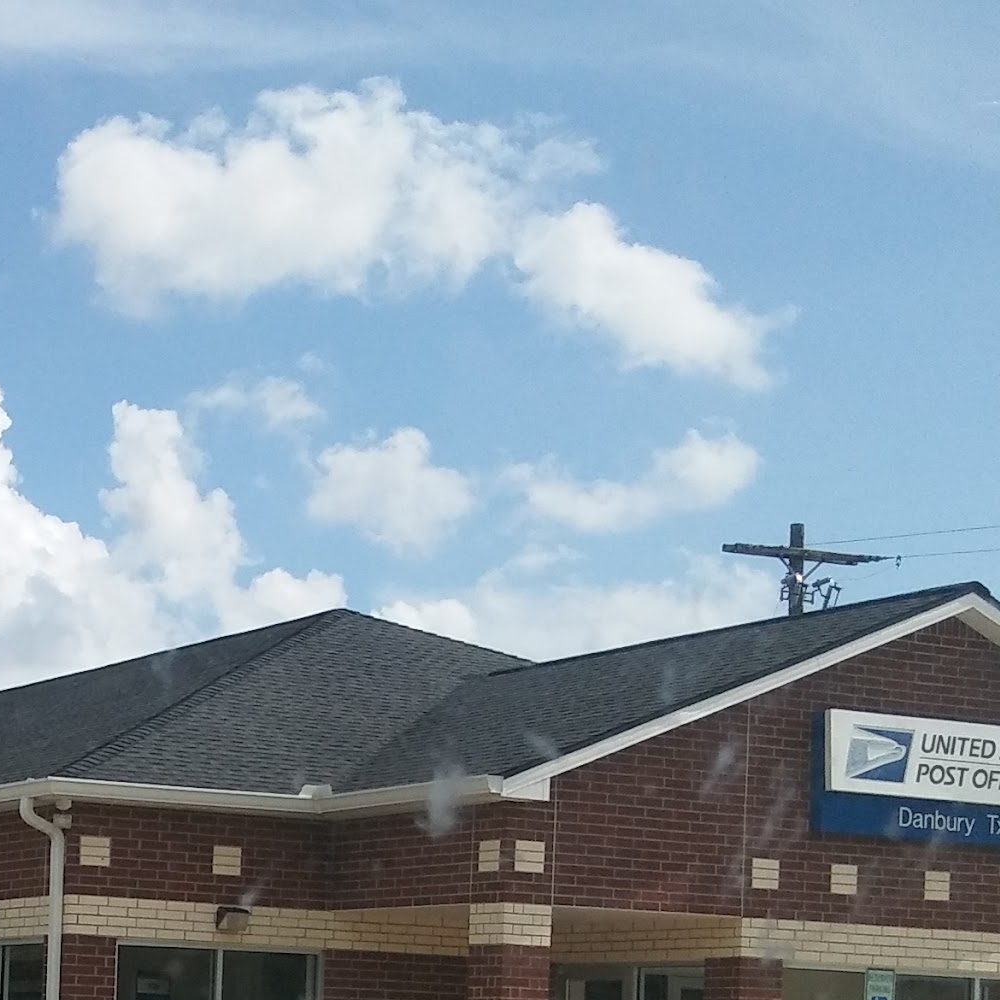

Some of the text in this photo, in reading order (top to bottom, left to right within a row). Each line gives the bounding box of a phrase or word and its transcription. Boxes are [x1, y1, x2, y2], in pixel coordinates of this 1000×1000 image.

[921, 733, 996, 759] UNITED
[916, 764, 1000, 789] POST OF
[899, 806, 976, 837] Danbury
